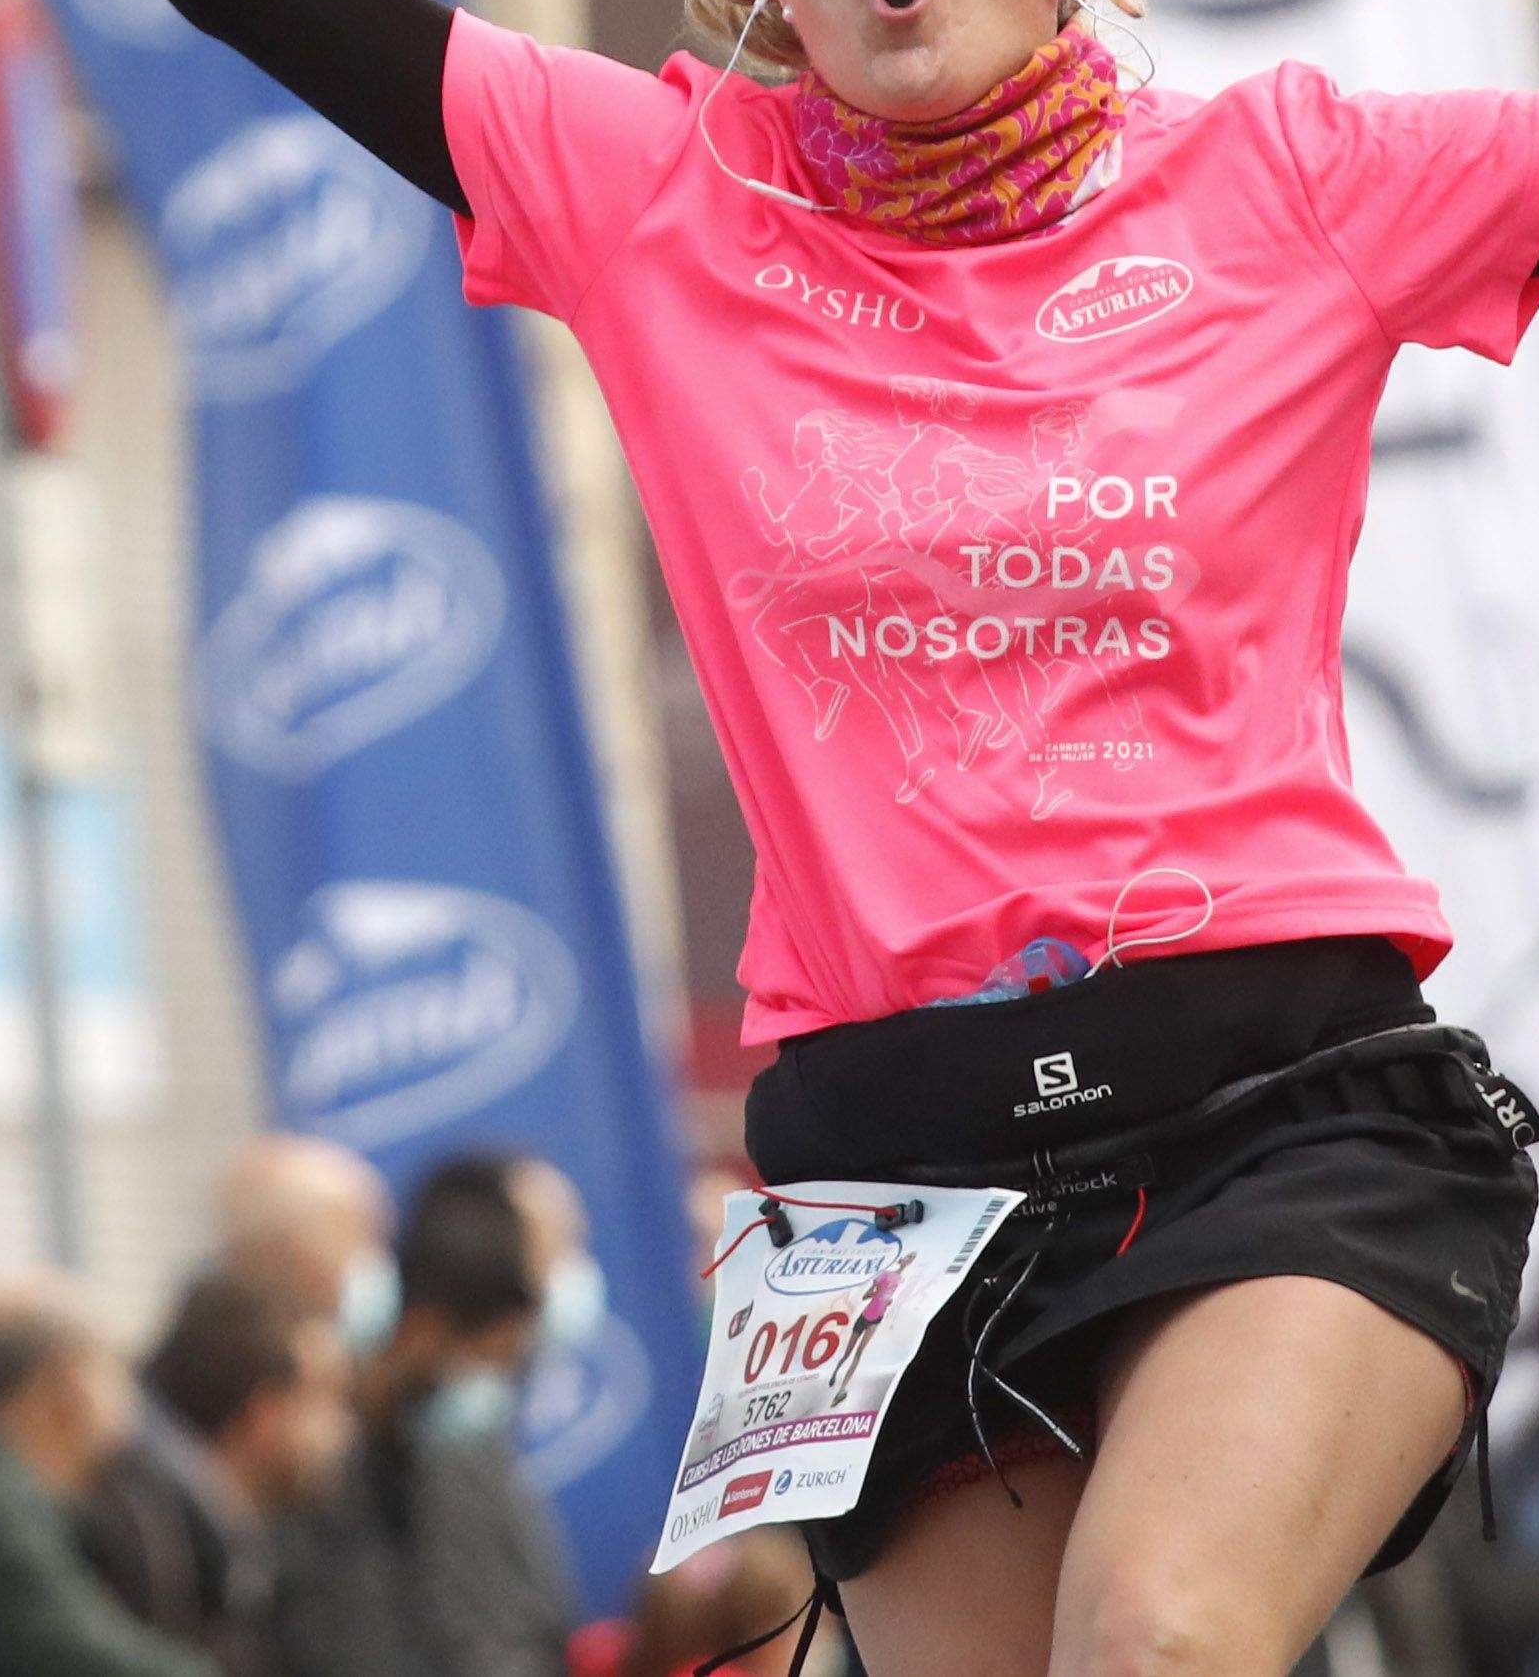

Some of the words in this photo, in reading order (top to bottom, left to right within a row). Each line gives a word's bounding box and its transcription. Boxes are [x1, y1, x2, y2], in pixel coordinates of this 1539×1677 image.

[754, 263, 926, 333] OYSHO
[1050, 275, 1184, 335] ASTURIANA
[1046, 474, 1178, 520] POR
[960, 544, 1175, 591] TODAS
[828, 614, 1172, 661] NOSOTRAS
[1101, 740, 1155, 760] 2021
[744, 1311, 849, 1384] 016
[743, 1389, 792, 1428] 5762
[772, 1424, 794, 1446] DE
[789, 1415, 873, 1441] BARCELONA
[796, 1469, 847, 1488] ZURICH
[670, 1495, 720, 1543] OYSHO
